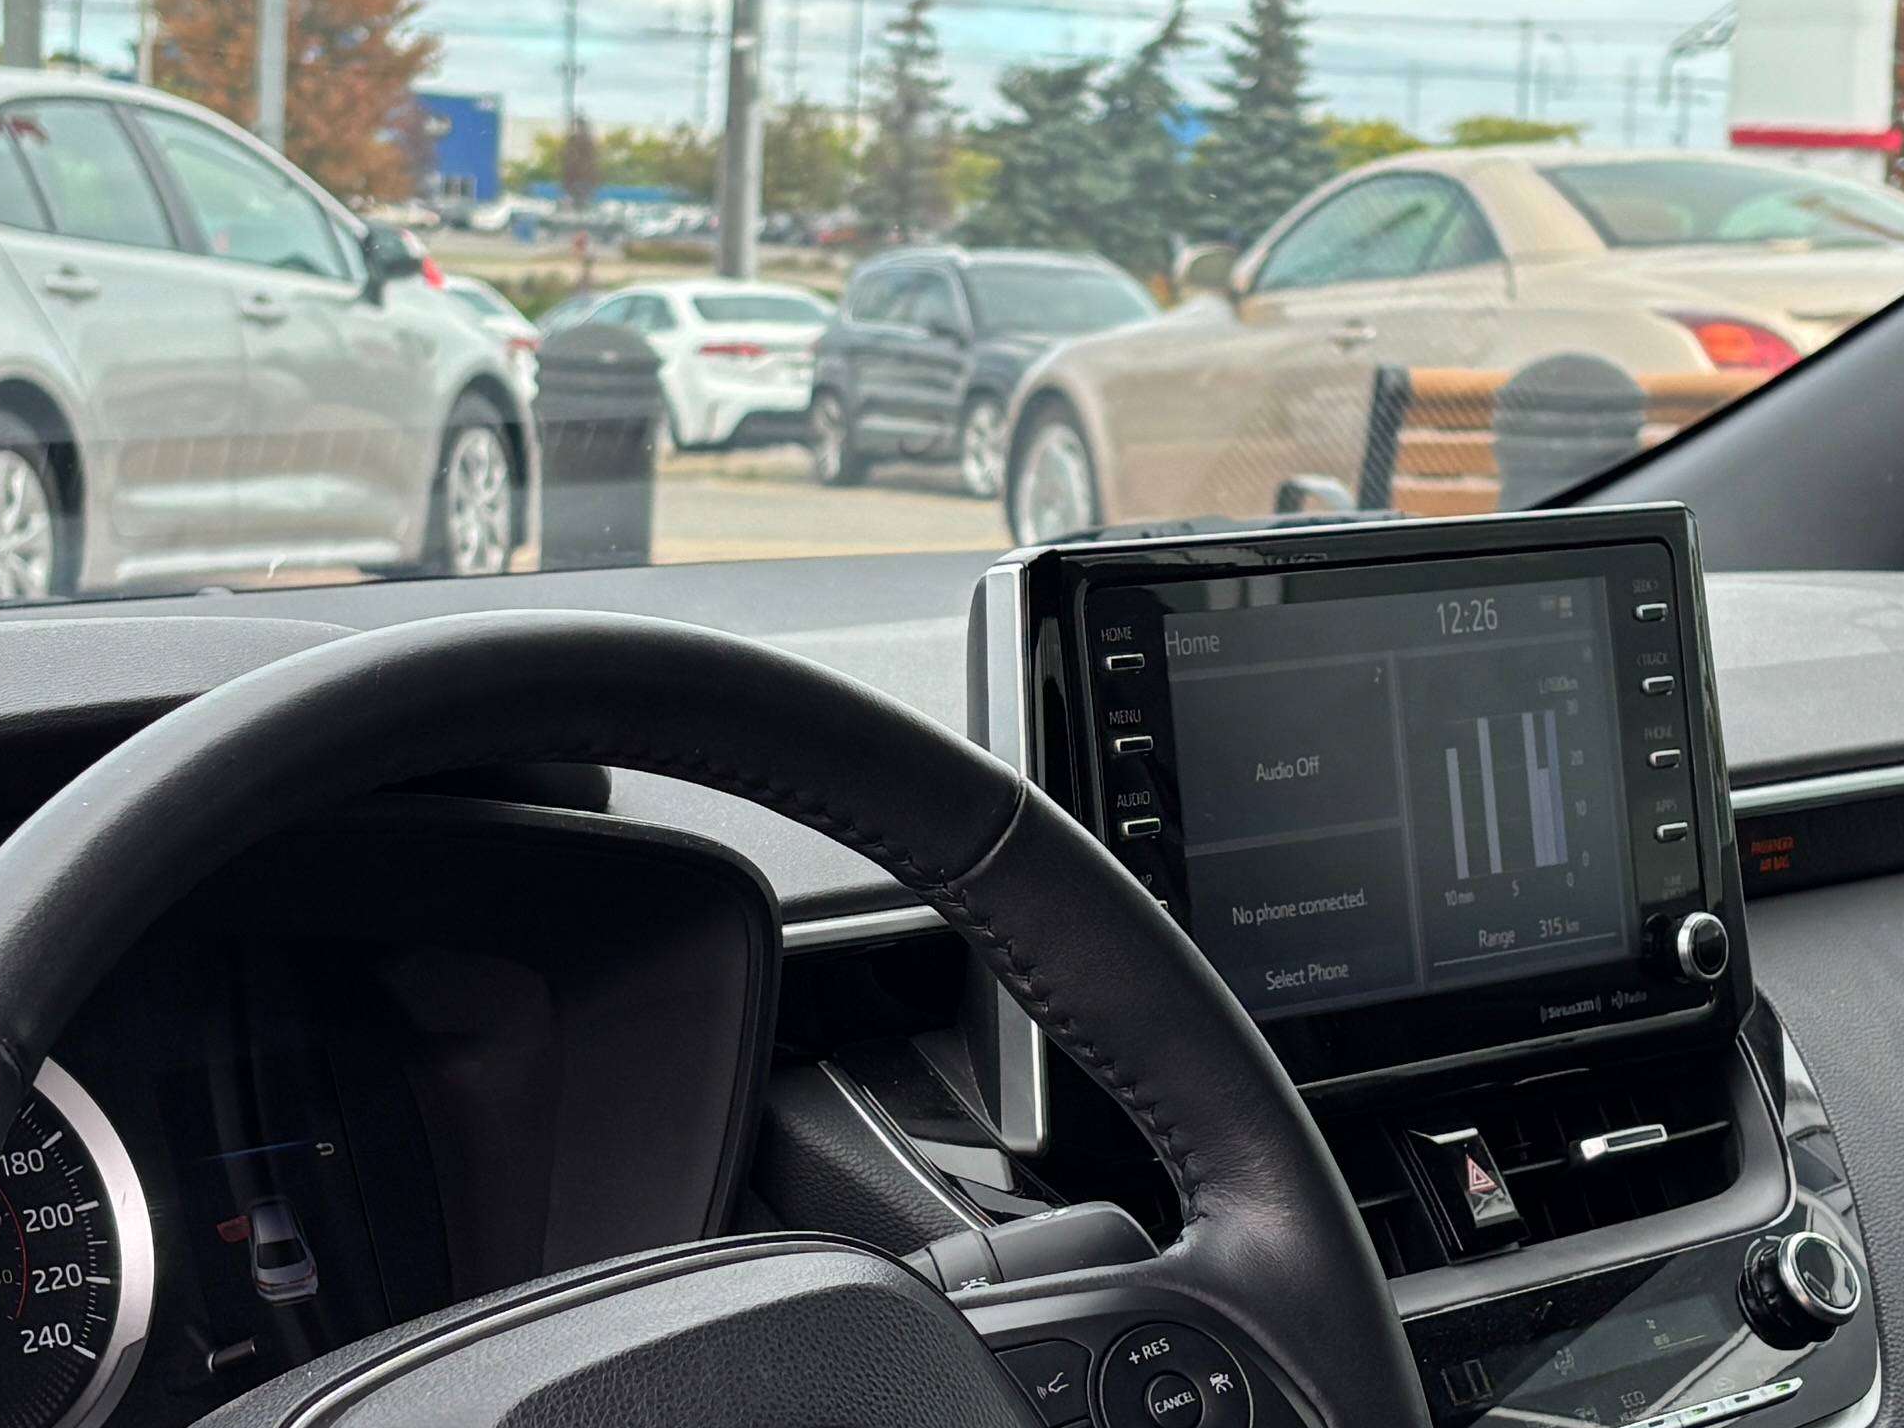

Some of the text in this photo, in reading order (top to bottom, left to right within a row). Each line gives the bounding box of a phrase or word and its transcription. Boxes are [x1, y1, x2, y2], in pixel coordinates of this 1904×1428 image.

[1436, 598, 1498, 635] 12:26
[1101, 626, 1133, 642] HOME
[1164, 630, 1221, 656] Home
[1109, 709, 1142, 725] MENU
[1256, 755, 1320, 781] Audio Off
[1116, 791, 1151, 808] AUDIO
[1575, 799, 1588, 817] 10
[1232, 888, 1368, 926] No phone connected.
[1445, 890, 1457, 907] 10
[1479, 928, 1516, 949] Range
[1539, 916, 1563, 939] 315
[1265, 962, 1350, 990] Select Phone
[23, 1202, 74, 1233] 200
[32, 1263, 83, 1294] 220
[21, 1322, 72, 1354] 240
[1141, 1338, 1170, 1360] RES
[1154, 1390, 1196, 1414] CANCEL
[1620, 1390, 1646, 1409] ECO
